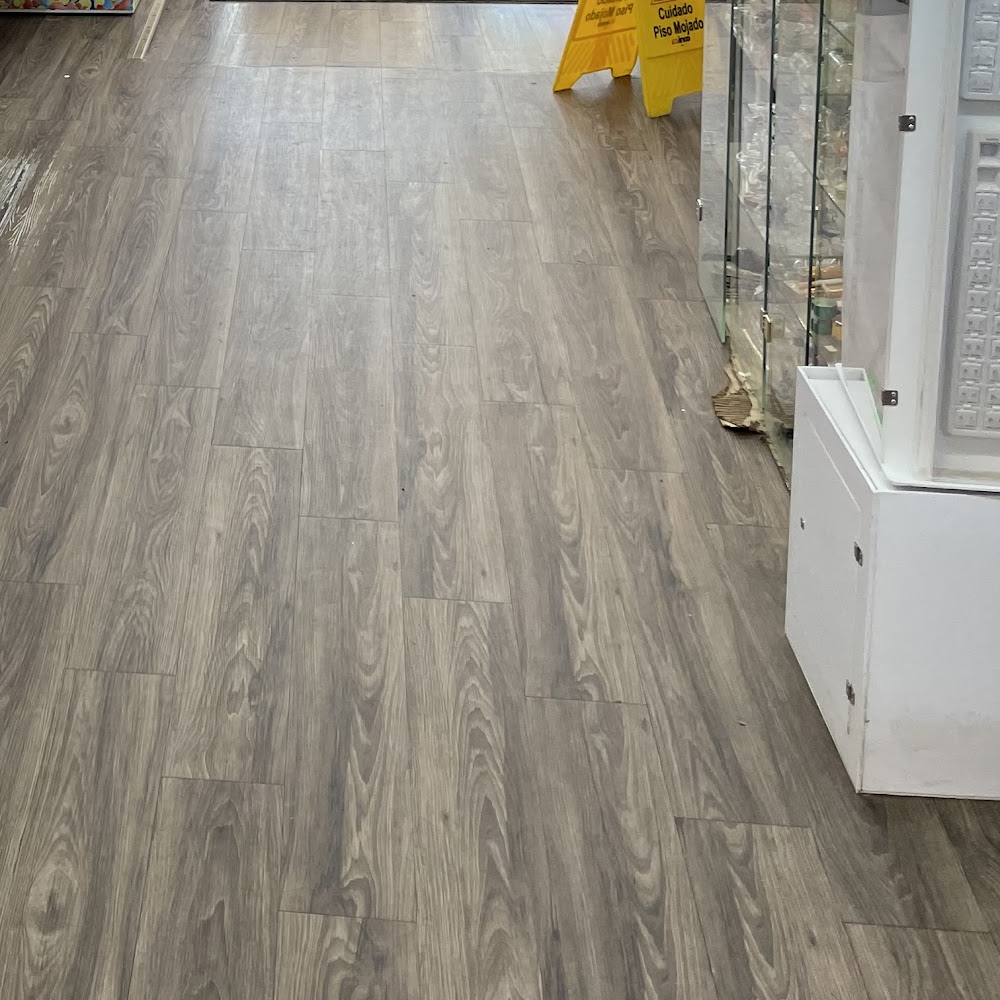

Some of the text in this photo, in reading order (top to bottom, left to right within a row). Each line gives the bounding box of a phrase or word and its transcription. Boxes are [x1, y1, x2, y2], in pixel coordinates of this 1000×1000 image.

[658, 2, 693, 20] Cuidado
[653, 19, 704, 39] Piso Mojado
